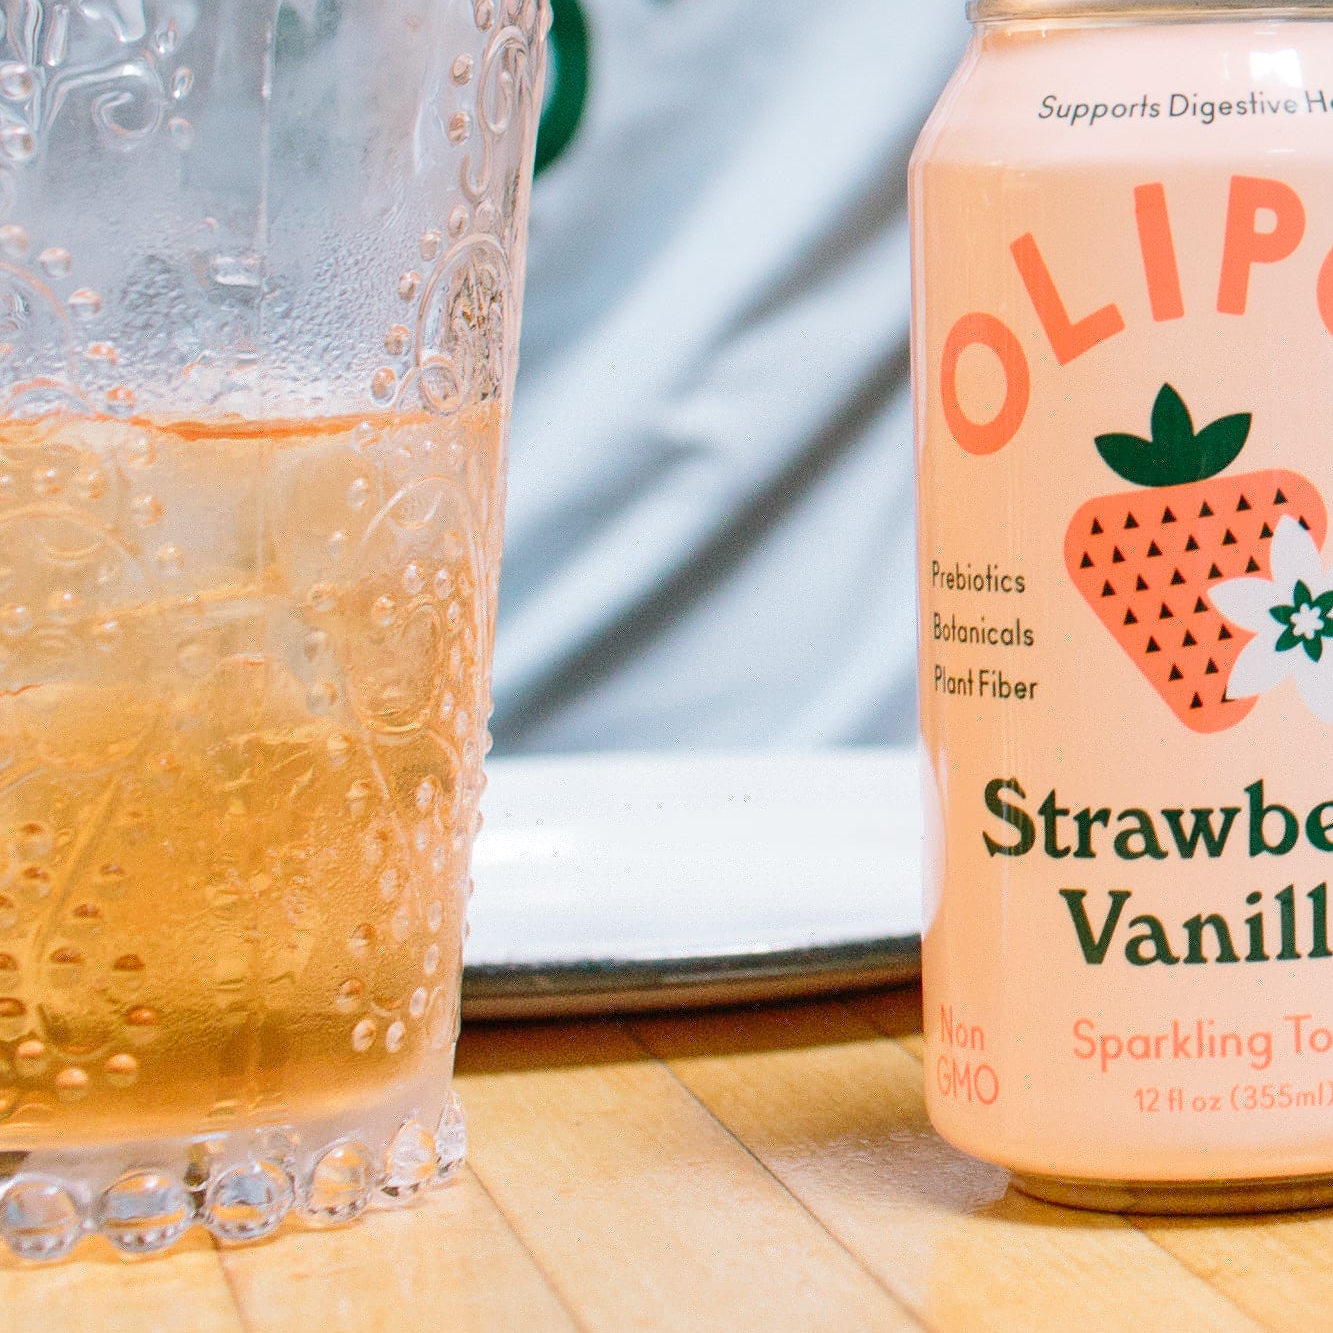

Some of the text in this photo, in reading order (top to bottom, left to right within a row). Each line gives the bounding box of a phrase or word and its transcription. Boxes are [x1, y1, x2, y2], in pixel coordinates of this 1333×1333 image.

[1038, 94, 1161, 126] Supports
[1170, 91, 1299, 124] Digestive
[931, 561, 1025, 593] Prebiotics
[932, 613, 1034, 646] Botanicals
[934, 665, 1038, 700] Plant Fiber
[940, 1005, 984, 1051] Non
[1073, 1018, 1273, 1072] Sparkling
[936, 1056, 999, 1105] GMO
[1134, 1088, 1160, 1113] 12
[1167, 1086, 1184, 1112] fl
[1192, 1091, 1222, 1113] oz
